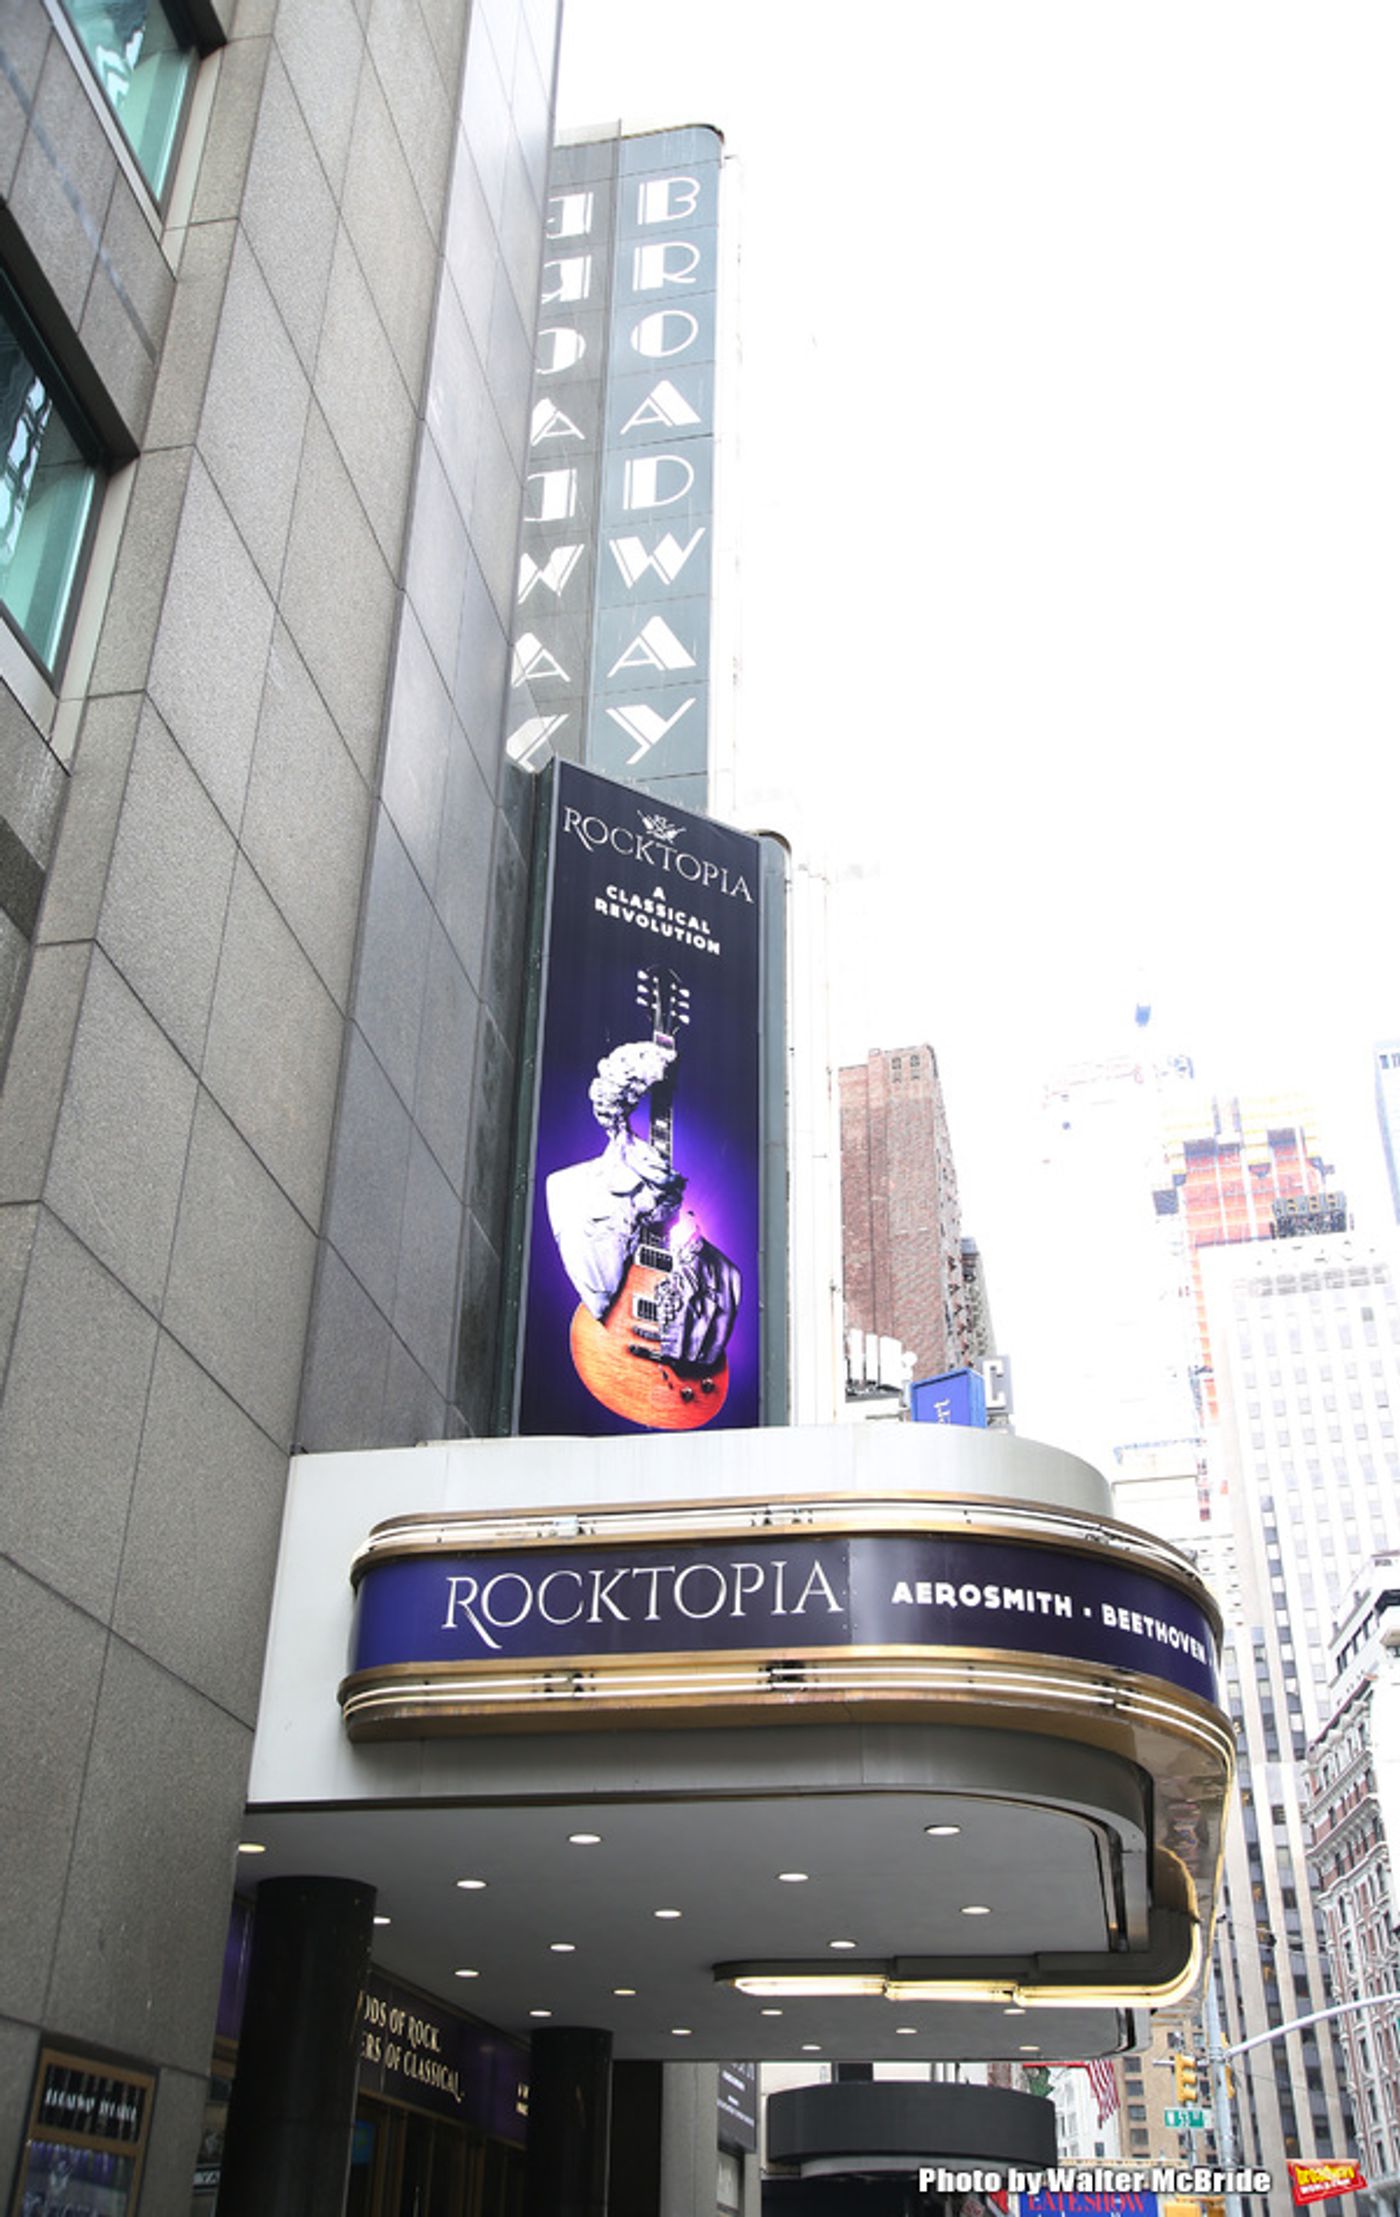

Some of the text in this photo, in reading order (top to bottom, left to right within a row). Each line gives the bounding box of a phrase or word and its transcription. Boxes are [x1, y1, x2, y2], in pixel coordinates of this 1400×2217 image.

[605, 176, 706, 765] BROADWAY
[563, 805, 755, 905] ROCKTOPIA
[605, 884, 711, 936] CLASSICAL
[652, 886, 666, 901] A
[593, 897, 721, 956] REVOLUTION
[441, 1560, 844, 1650] ROCKTOPIA
[891, 1580, 1207, 1666] AEROSMITH BEETHOVEN
[389, 2008, 406, 2037] OF
[384, 2043, 402, 2072] OF
